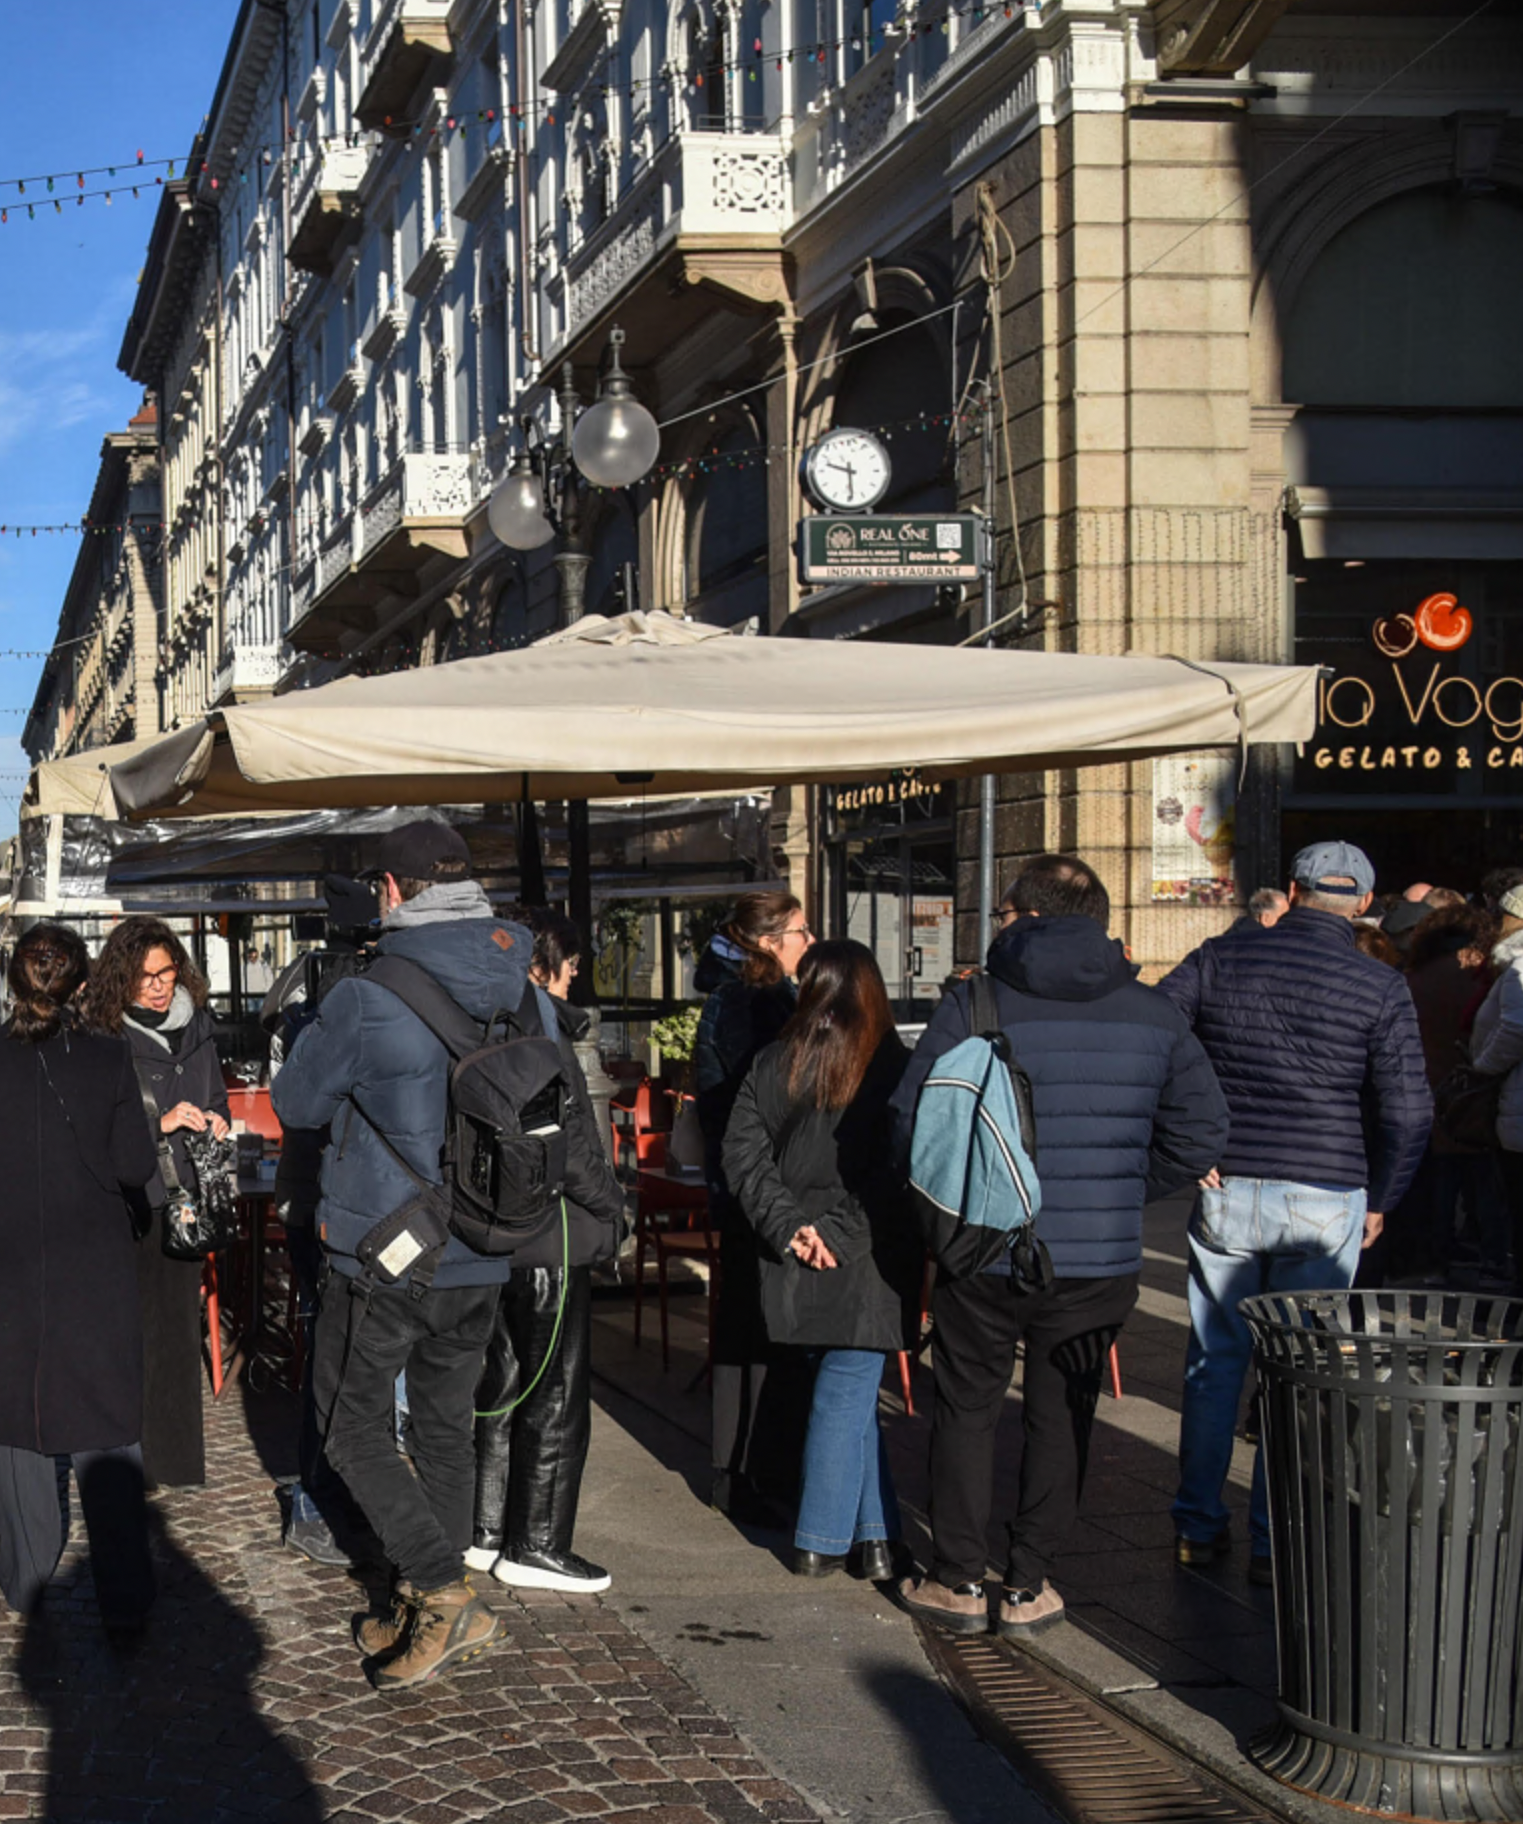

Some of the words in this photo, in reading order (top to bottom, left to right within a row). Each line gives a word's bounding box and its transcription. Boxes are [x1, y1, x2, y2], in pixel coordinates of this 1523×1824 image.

[860, 527, 896, 541] REAL
[898, 524, 930, 541] ONE
[827, 567, 872, 577] INDIAN
[877, 567, 961, 577] RESTAURANT
[1315, 746, 1442, 769] GELATO
[1456, 747, 1472, 769] &
[837, 785, 884, 811] GELATO
